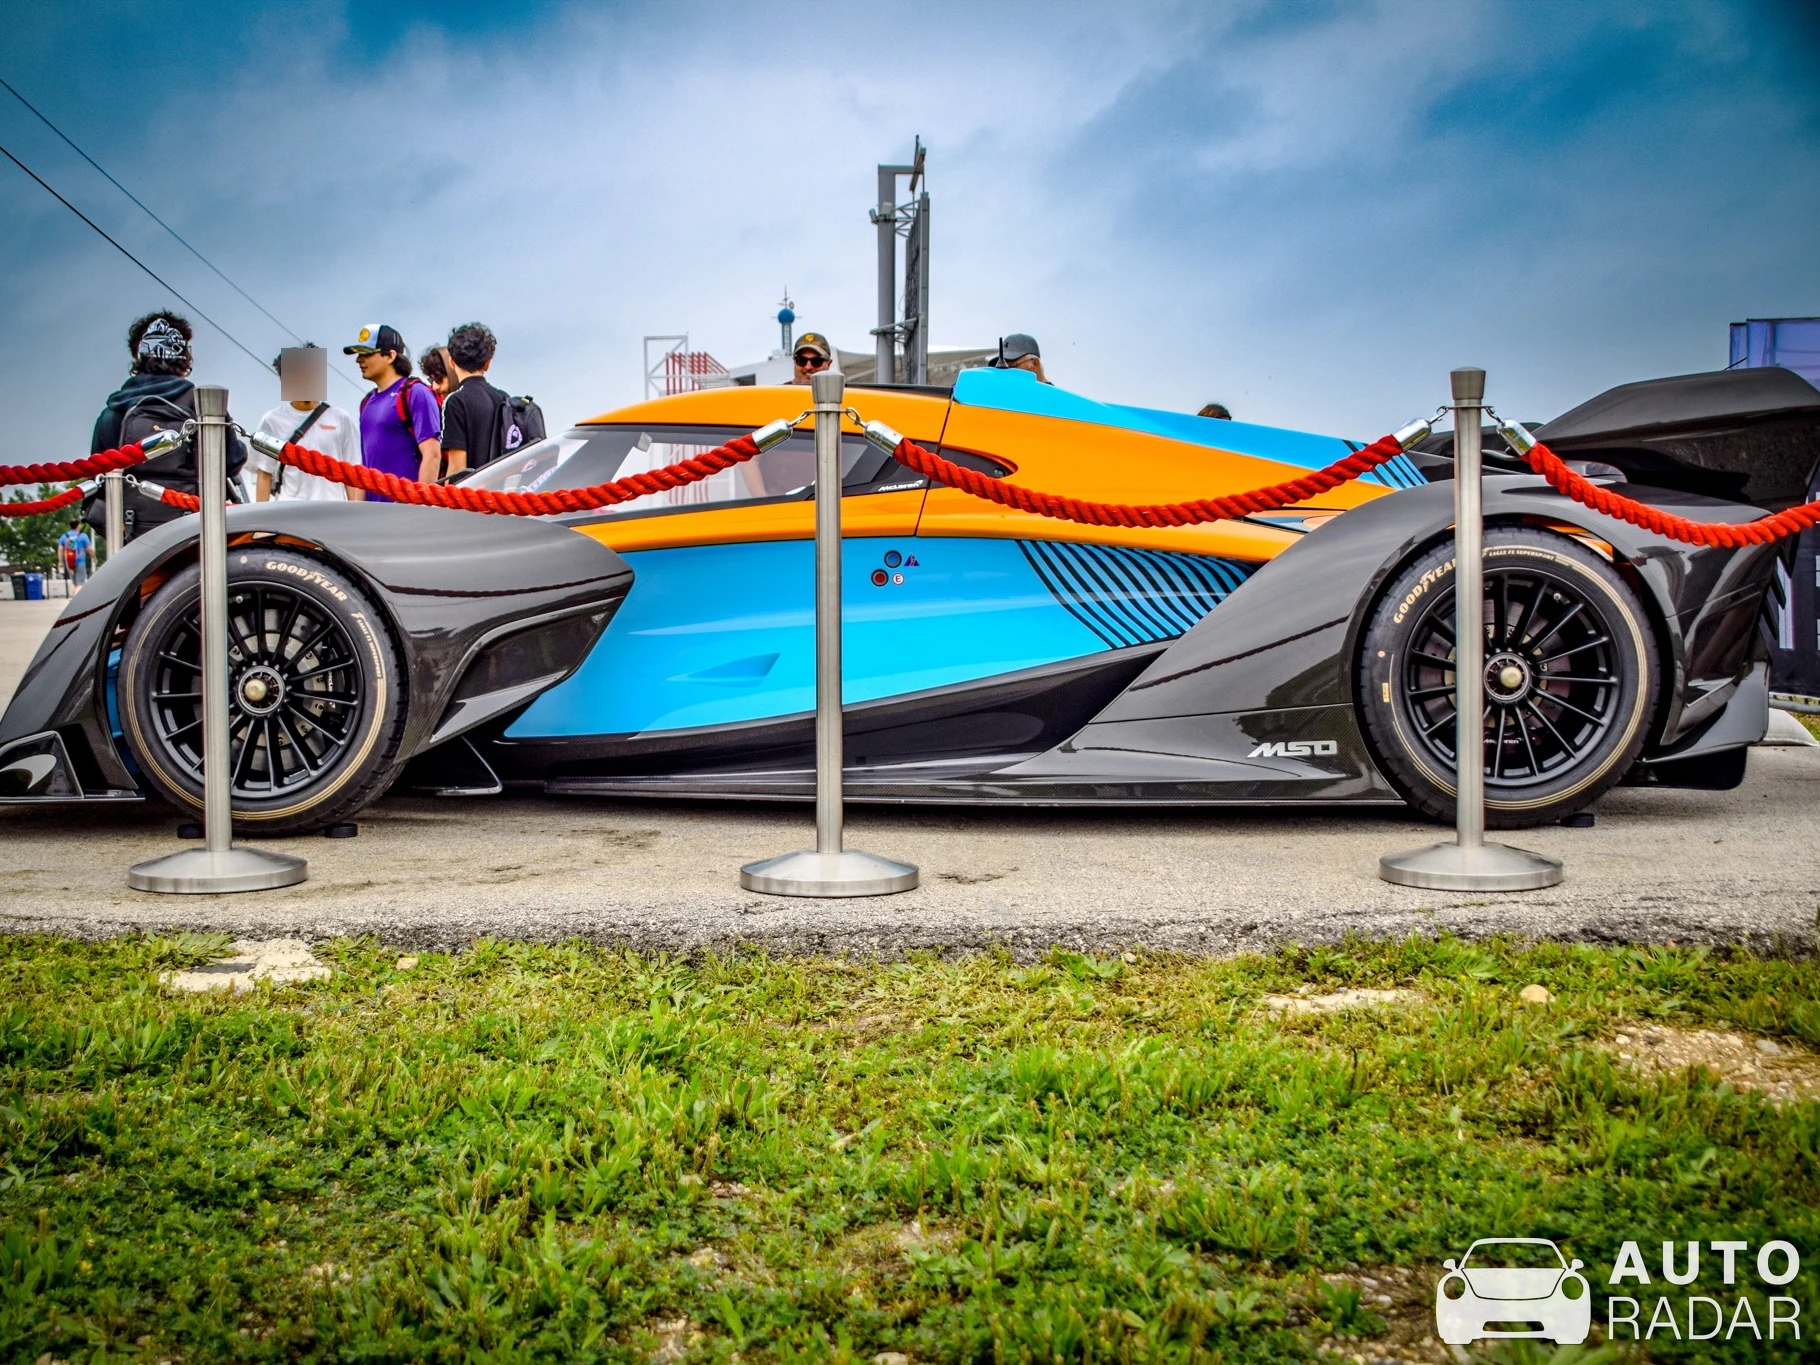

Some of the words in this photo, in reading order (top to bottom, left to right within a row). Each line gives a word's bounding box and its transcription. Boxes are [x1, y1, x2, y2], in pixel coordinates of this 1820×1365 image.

[1516, 550, 1555, 560] SUPERSPORT
[266, 561, 348, 601] GOODYEAR
[1246, 740, 1338, 758] MSO
